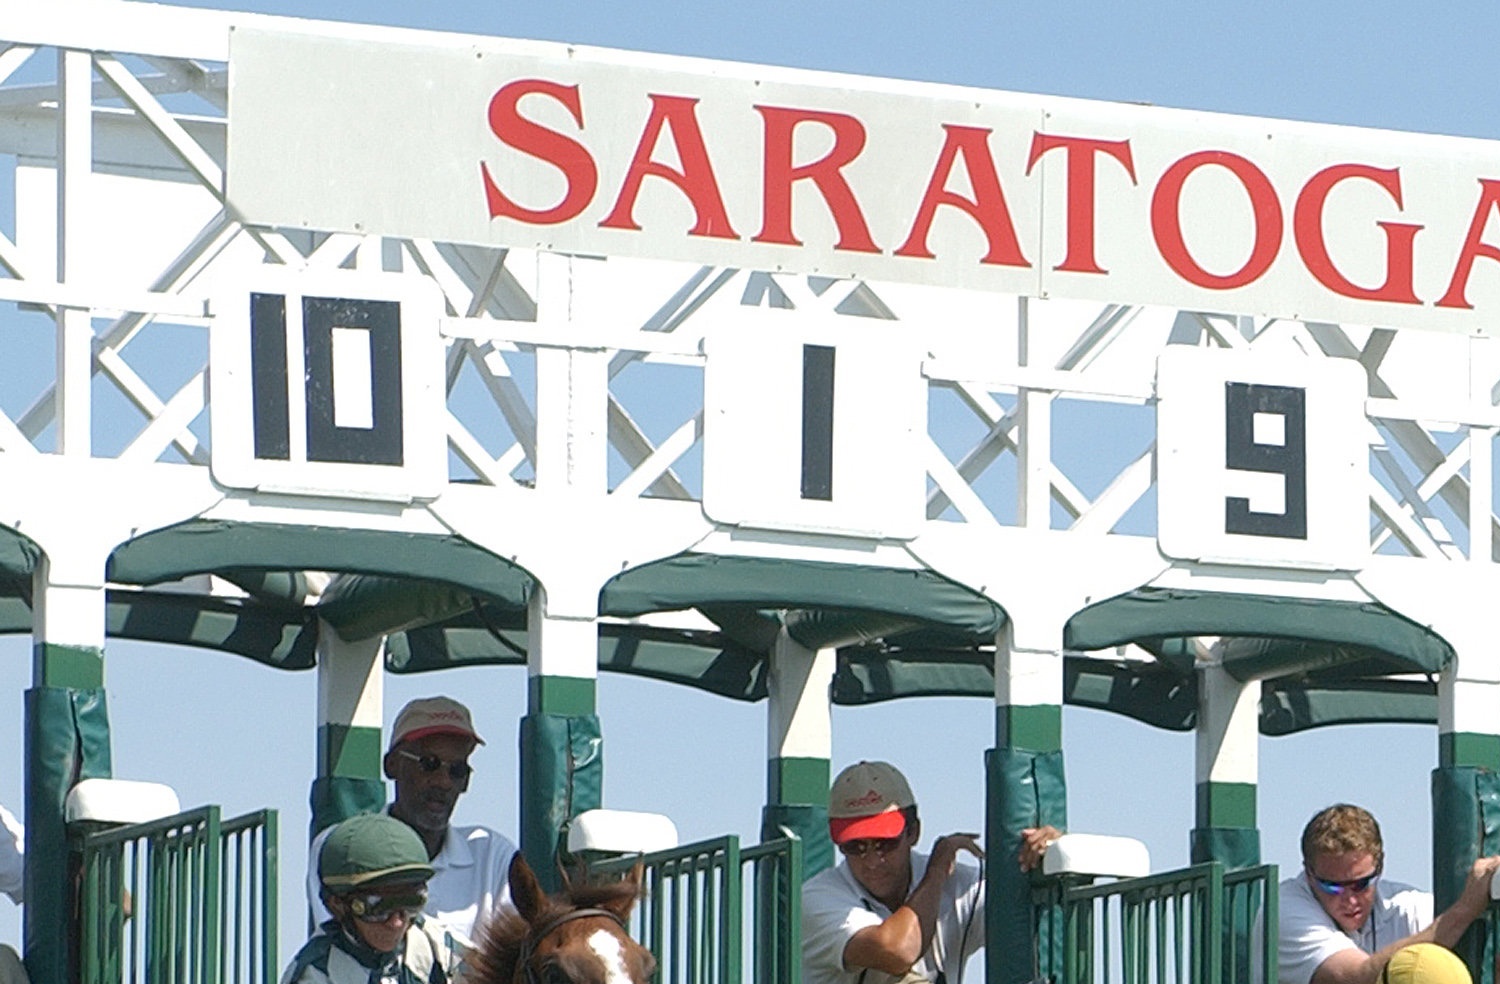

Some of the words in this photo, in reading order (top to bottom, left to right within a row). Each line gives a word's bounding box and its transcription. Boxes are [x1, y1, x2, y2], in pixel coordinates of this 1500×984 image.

[251, 293, 404, 467] 10
[801, 344, 836, 501] 1
[1225, 382, 1308, 540] 9
